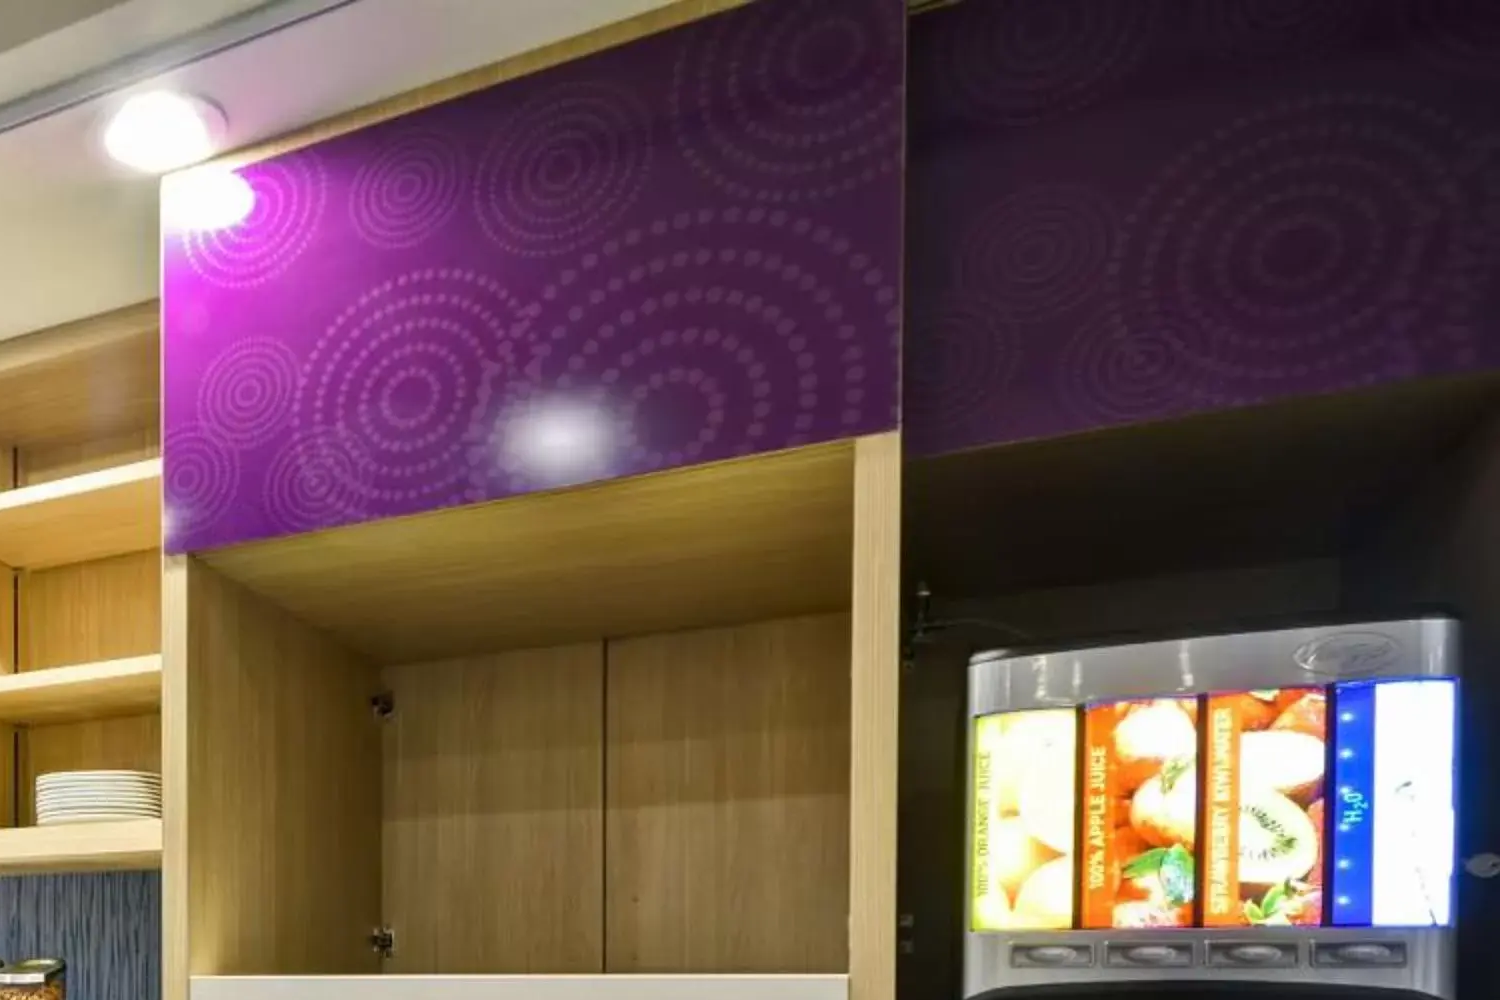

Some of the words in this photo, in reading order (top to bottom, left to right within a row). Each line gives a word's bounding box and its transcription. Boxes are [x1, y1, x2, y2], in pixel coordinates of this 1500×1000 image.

[978, 752, 991, 790] JUICE
[1090, 746, 1106, 789] JUICE
[977, 799, 989, 857] ORANGE
[1089, 795, 1105, 849] APPLE
[1089, 850, 1104, 889] 100%
